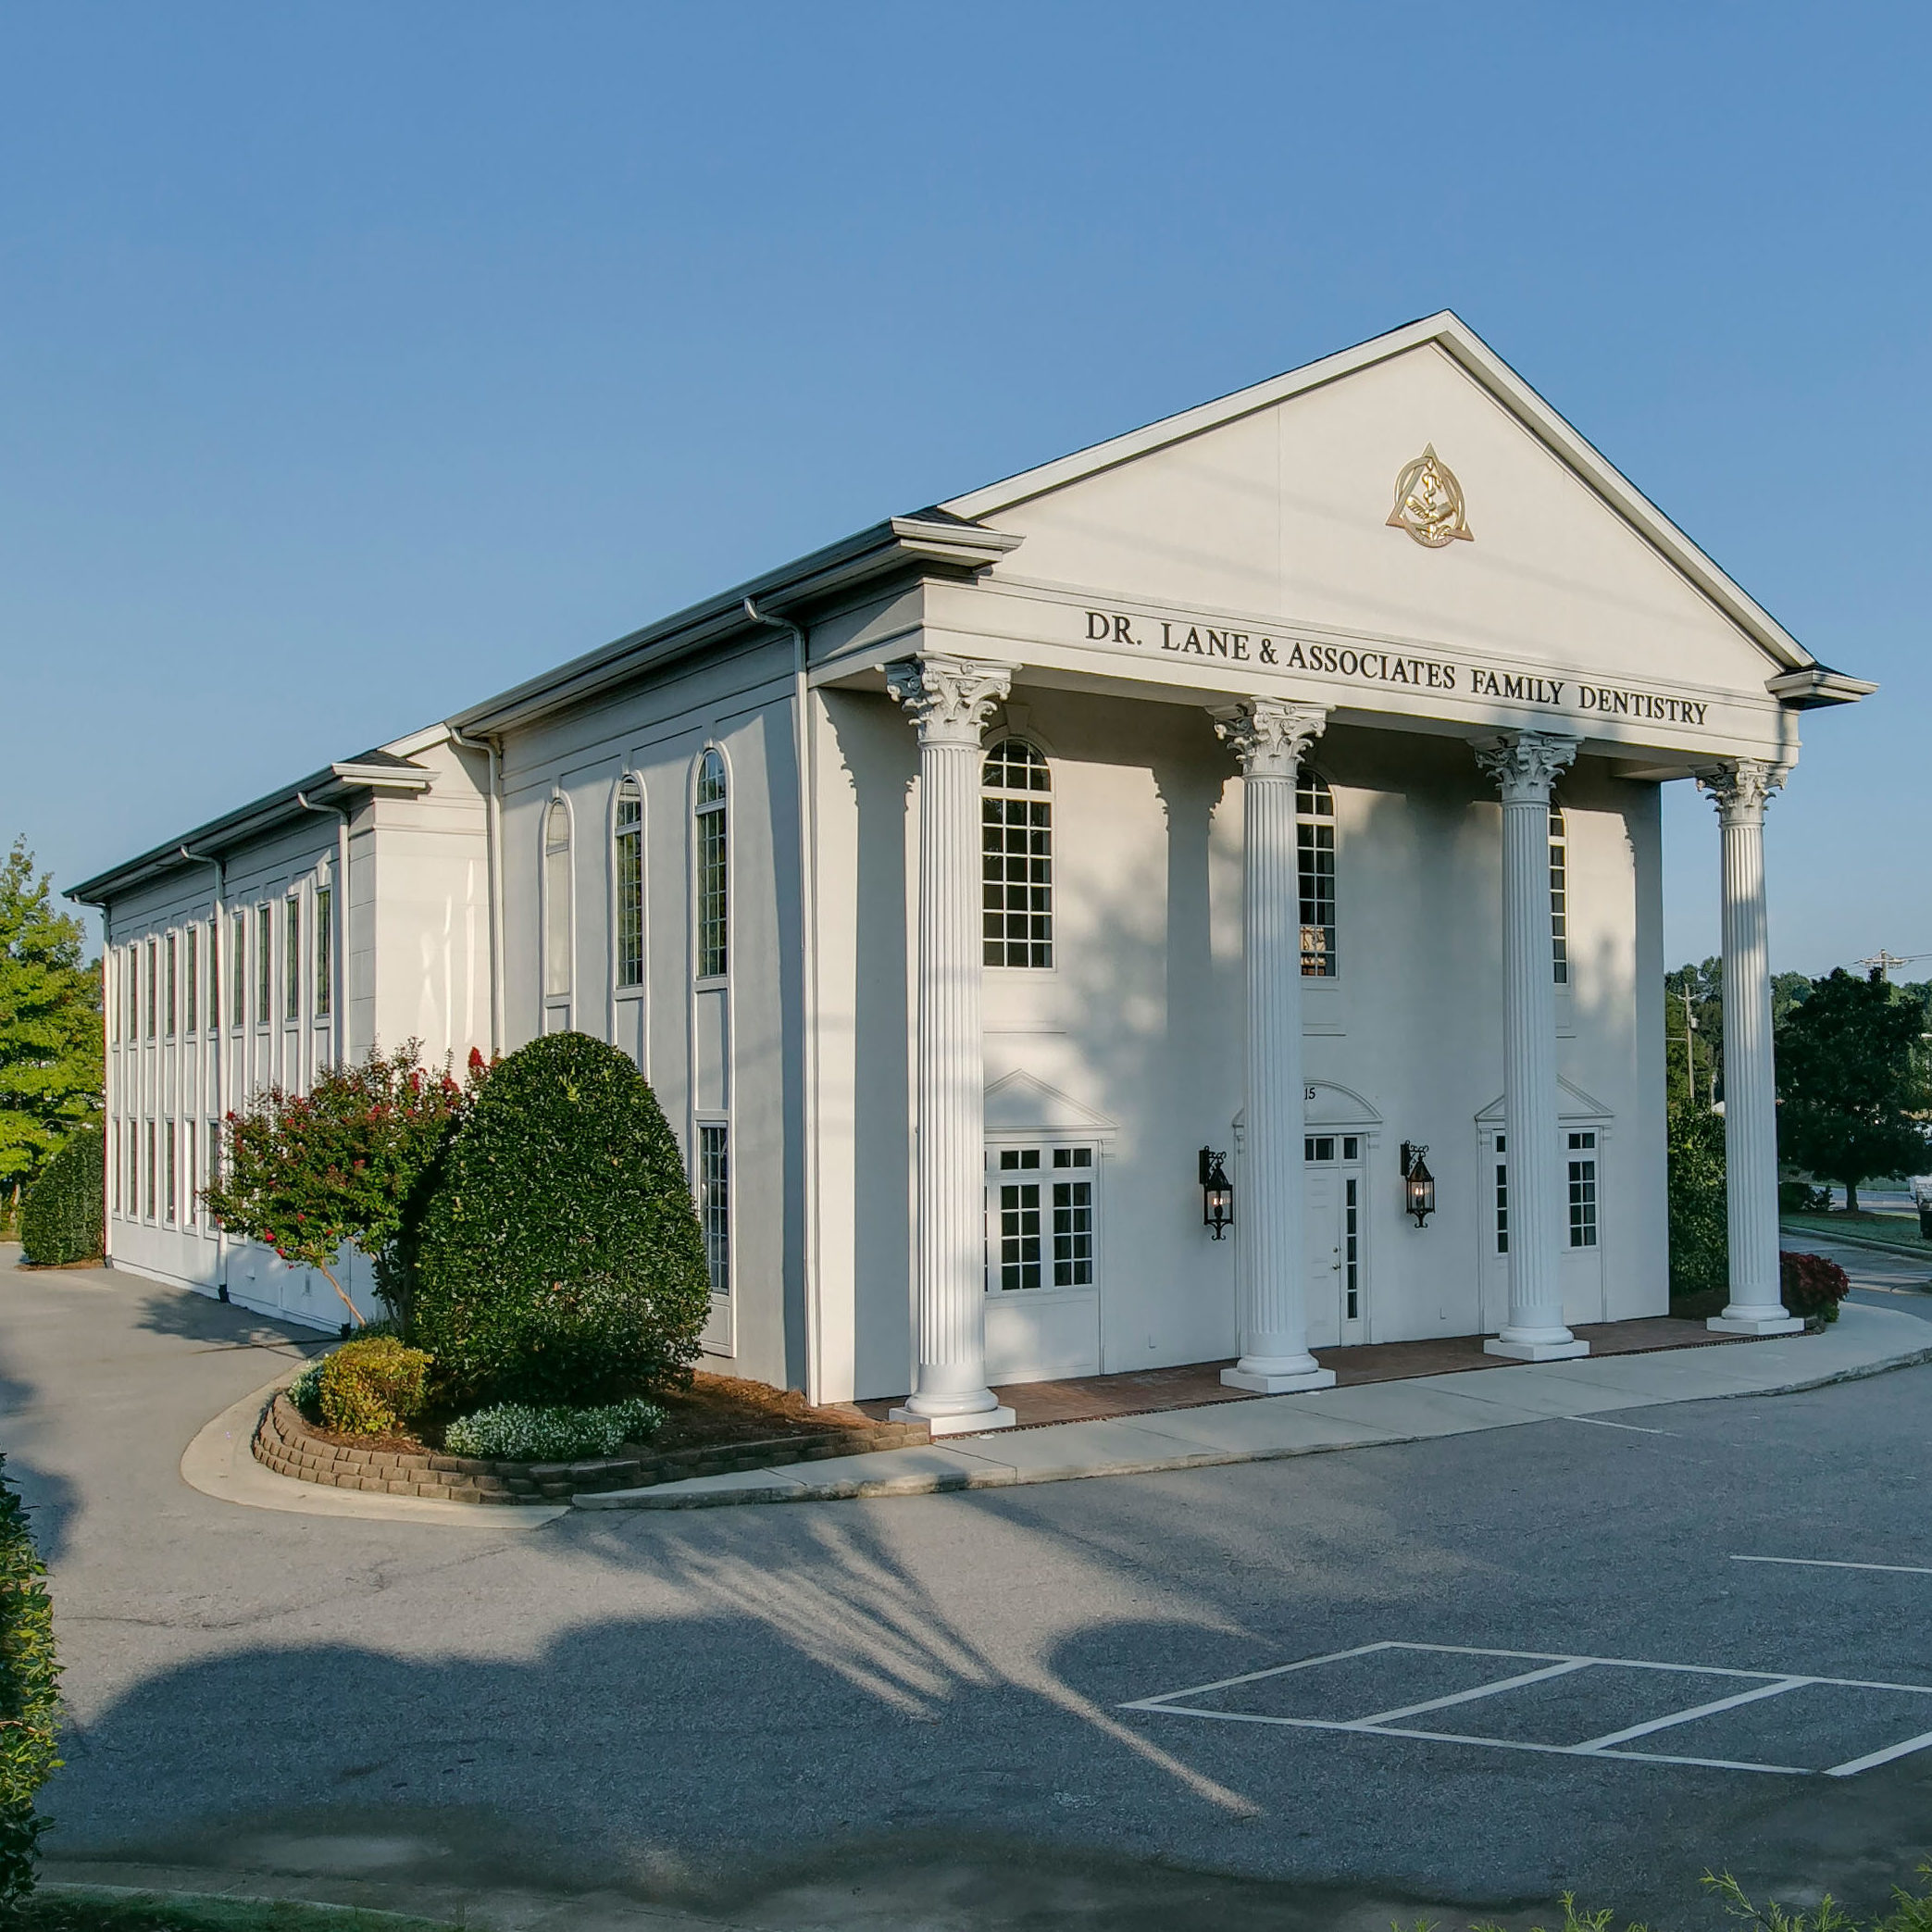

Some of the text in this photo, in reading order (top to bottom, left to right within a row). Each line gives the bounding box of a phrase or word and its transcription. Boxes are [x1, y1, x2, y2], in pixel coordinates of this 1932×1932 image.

[1085, 611, 1708, 726] DR. LANE & ASSOCIATES FAMILY DENTISTRY
